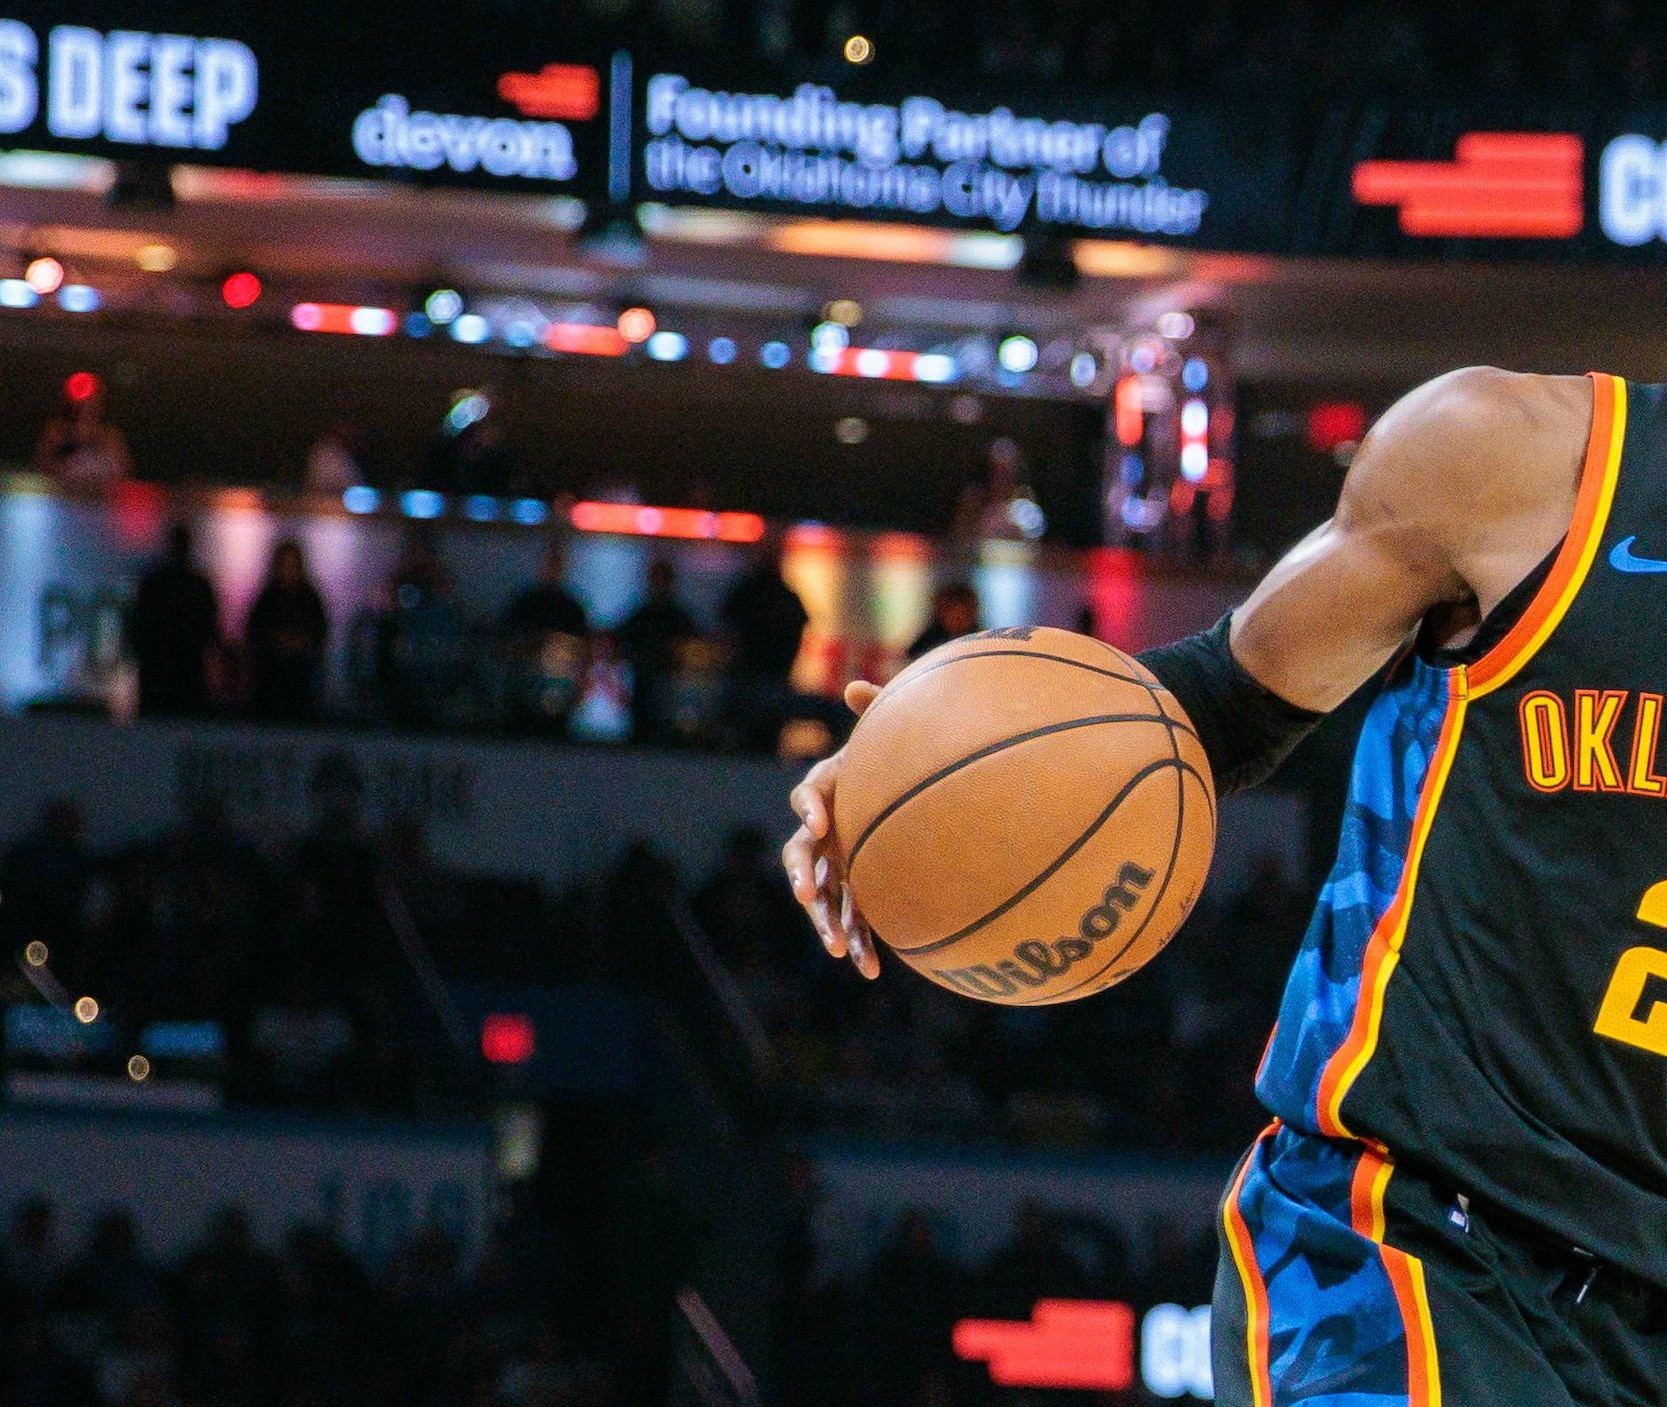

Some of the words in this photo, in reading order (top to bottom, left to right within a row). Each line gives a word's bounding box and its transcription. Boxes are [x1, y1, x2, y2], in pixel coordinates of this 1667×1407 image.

[48, 24, 258, 150] DEEP
[352, 93, 578, 181] devon
[646, 73, 900, 169] Founding
[901, 96, 1106, 174] Partner
[1104, 112, 1170, 179] of
[645, 135, 723, 195] the
[721, 139, 942, 213] Oklahoma
[941, 159, 1036, 232] City
[1035, 166, 1210, 236] Thunder
[932, 861, 1156, 998] Wilson
